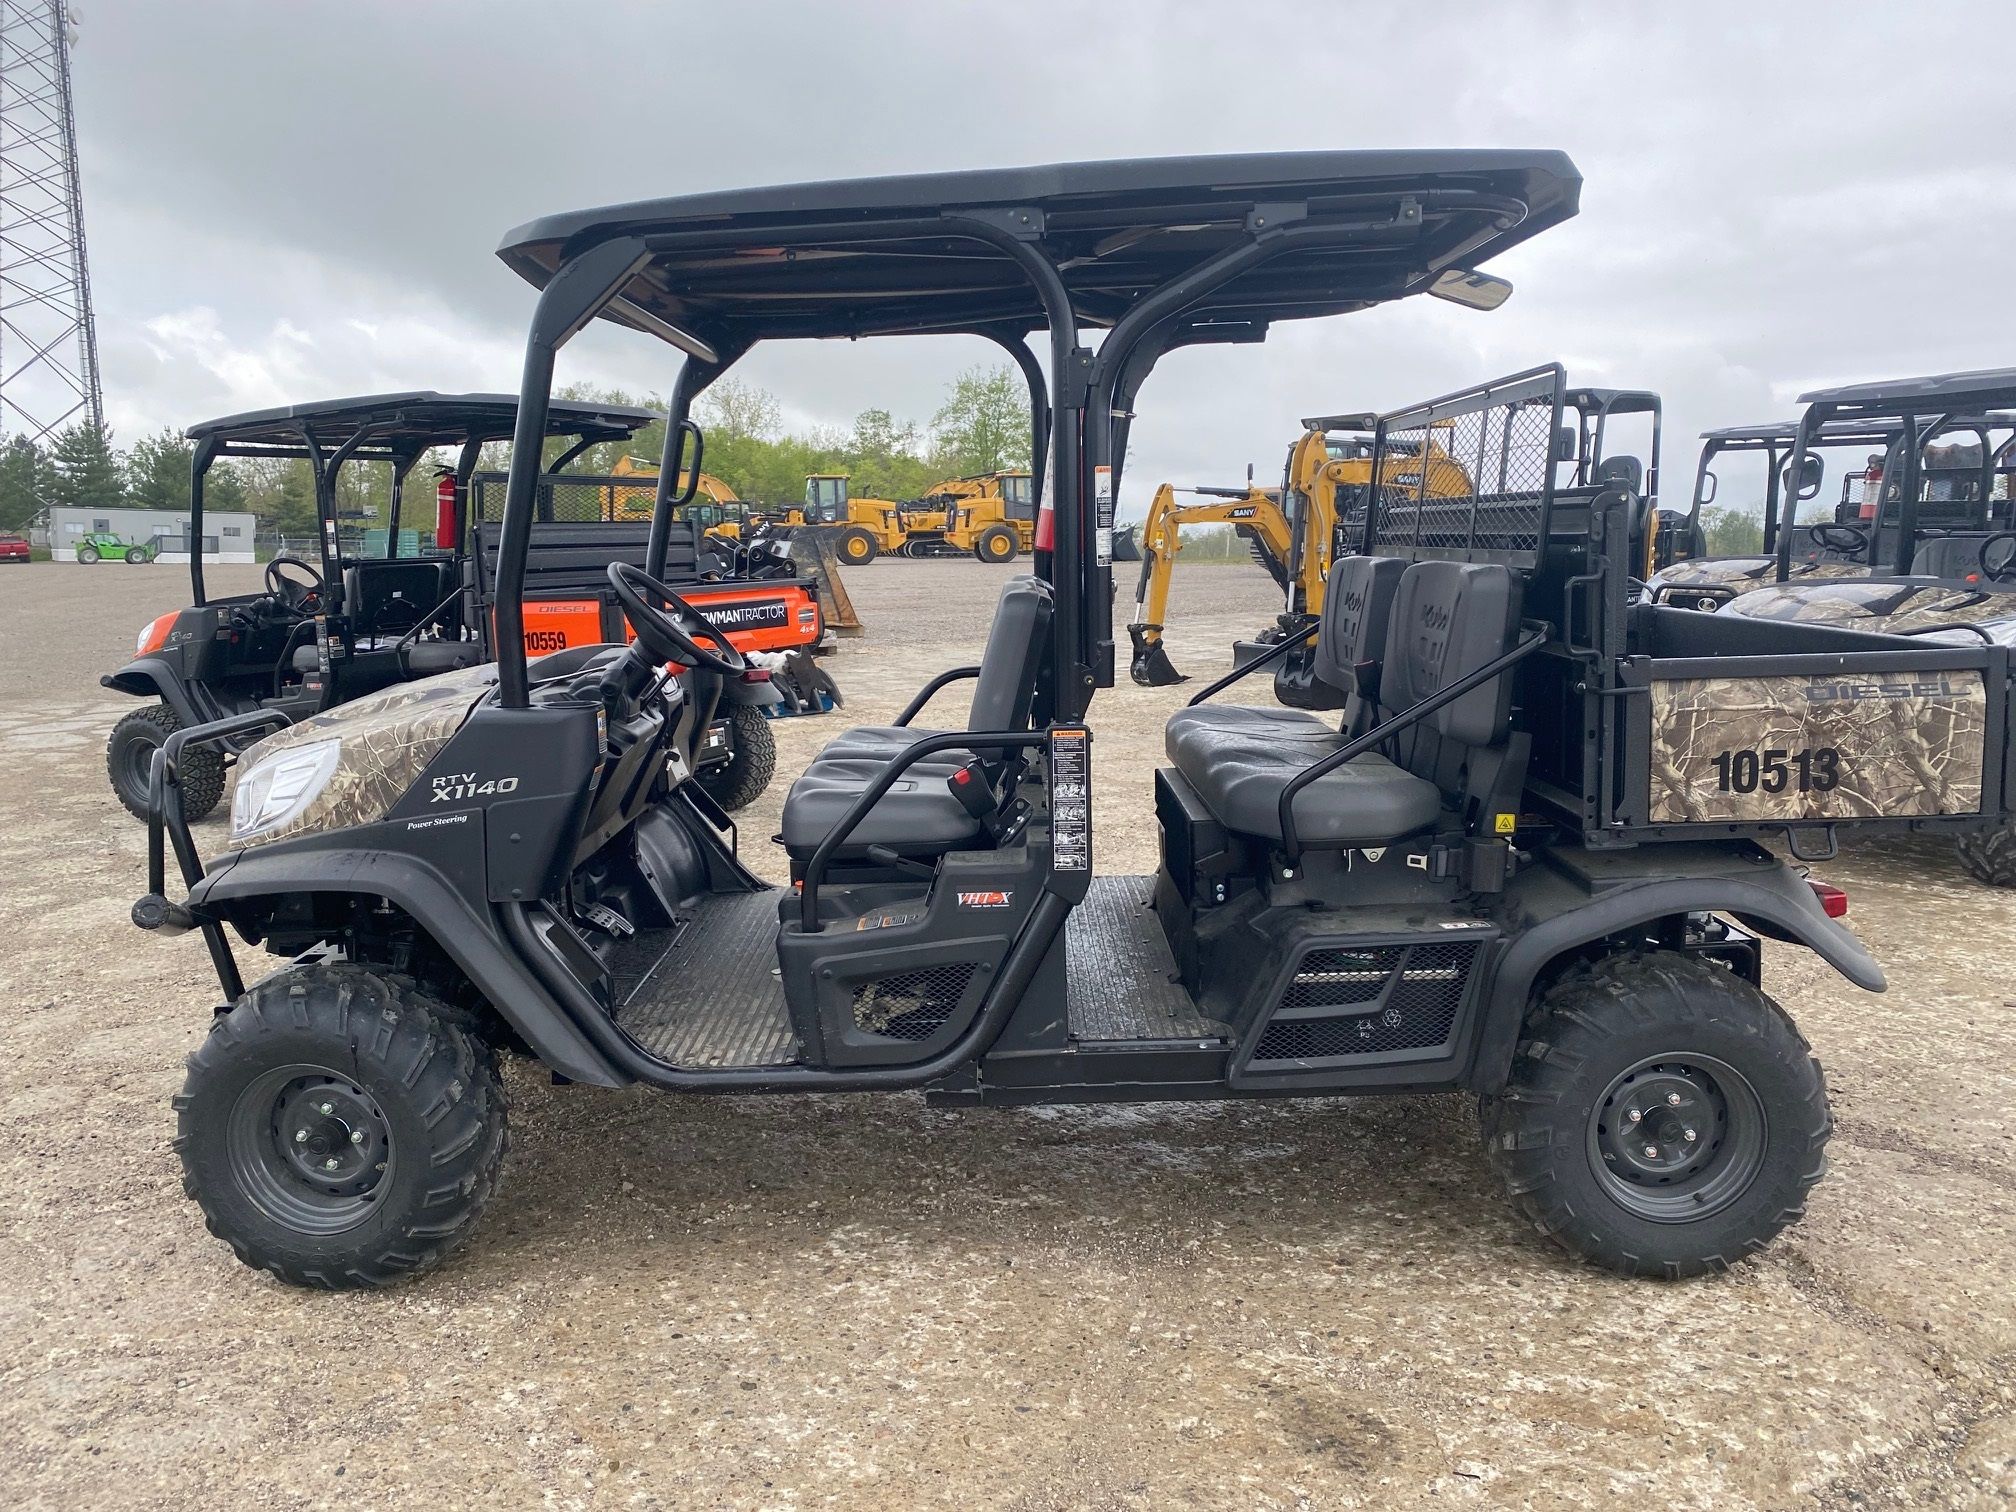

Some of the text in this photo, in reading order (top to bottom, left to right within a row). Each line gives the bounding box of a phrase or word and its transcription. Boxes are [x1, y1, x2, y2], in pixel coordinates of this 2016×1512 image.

[1233, 508, 1255, 517] SANY
[539, 605, 591, 613] DIESEL
[800, 623, 815, 634] 4x4
[524, 631, 567, 650] 10559
[1805, 681, 1972, 699] DIESEL
[1711, 748, 1840, 794] 10513
[432, 772, 476, 787] RTV
[430, 777, 519, 802] X1140
[407, 815, 468, 830] Power Steering
